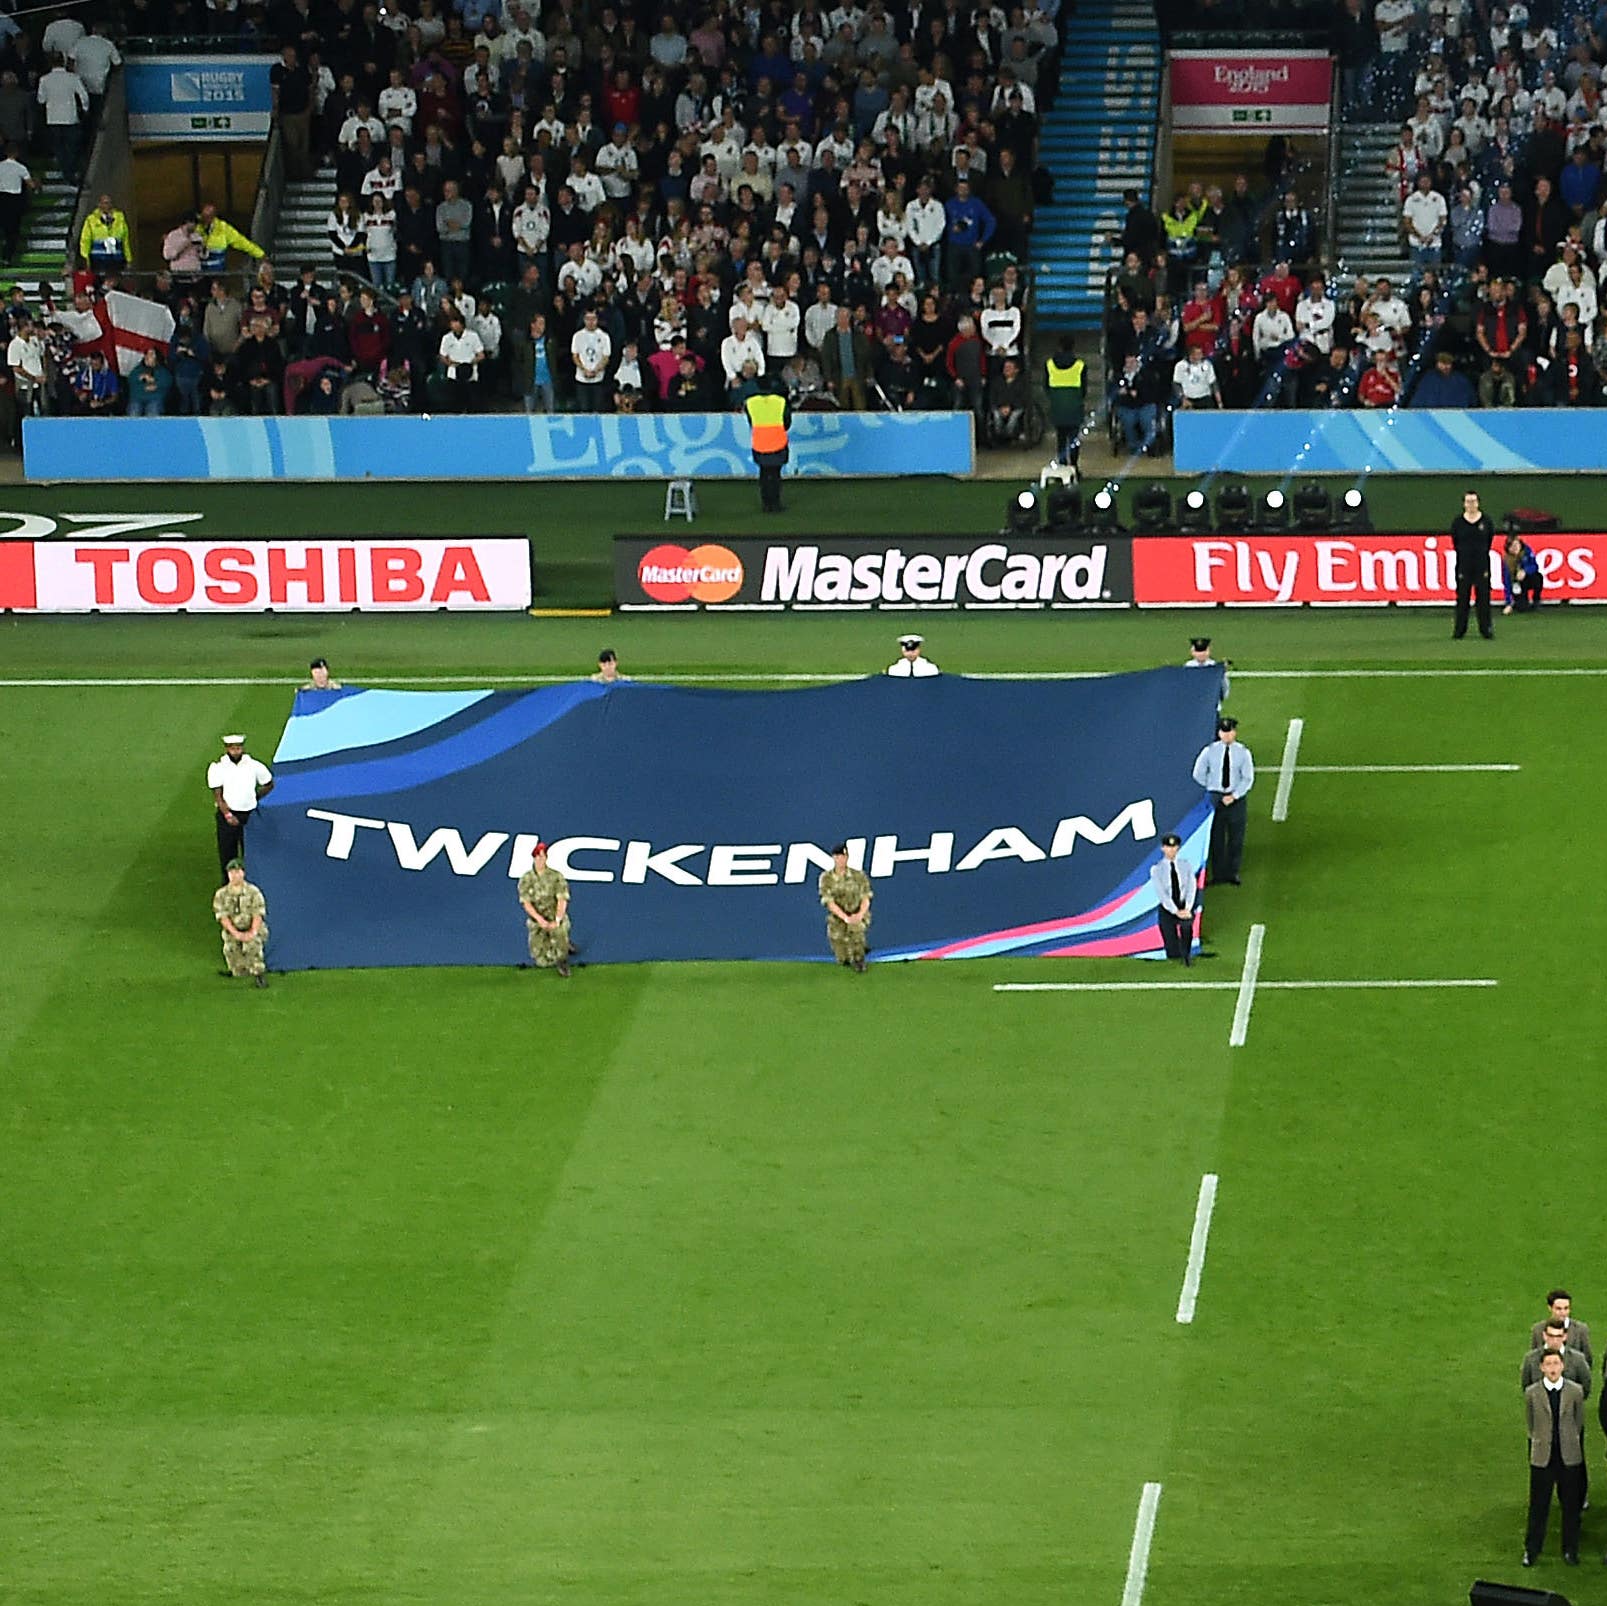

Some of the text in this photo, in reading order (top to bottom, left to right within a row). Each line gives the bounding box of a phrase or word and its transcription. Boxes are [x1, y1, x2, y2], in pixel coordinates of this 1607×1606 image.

[202, 91, 244, 102] 2015
[75, 546, 491, 605] TOSHIBA
[641, 563, 741, 584] MasterCard
[761, 544, 1107, 602] MasterCard
[1191, 536, 1598, 602] Fly Emires
[306, 797, 1158, 887] TWICKENHAM
